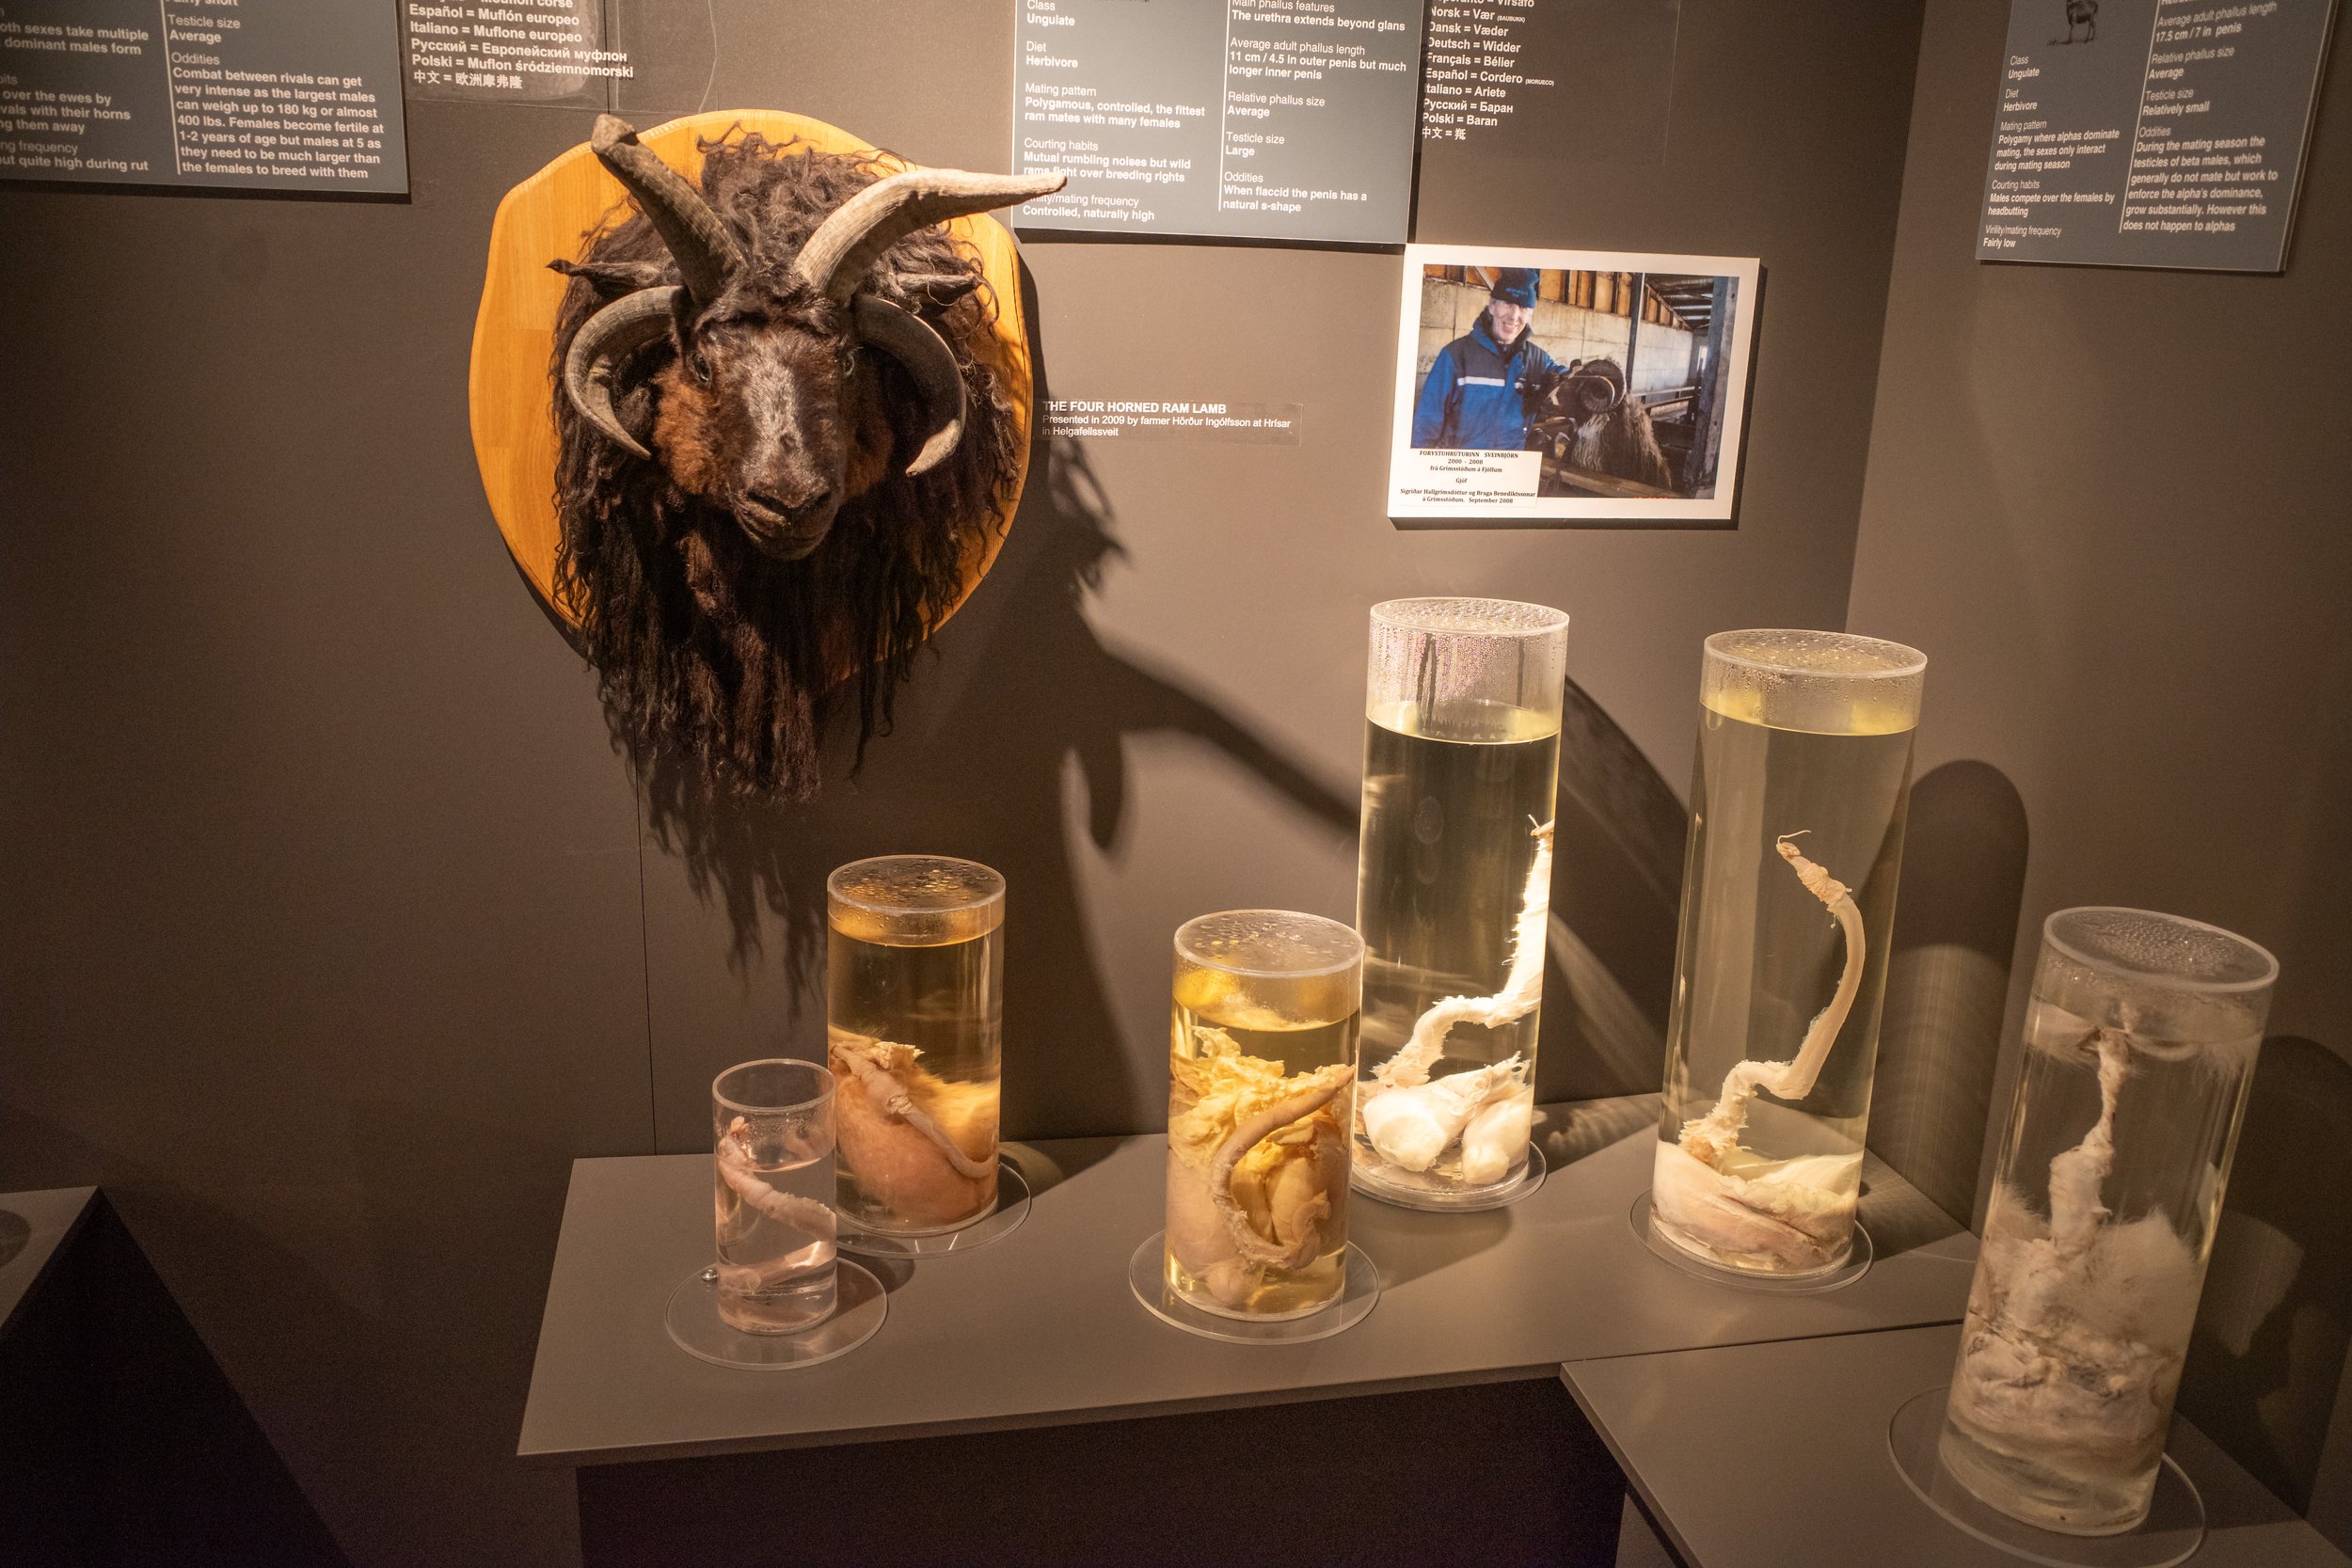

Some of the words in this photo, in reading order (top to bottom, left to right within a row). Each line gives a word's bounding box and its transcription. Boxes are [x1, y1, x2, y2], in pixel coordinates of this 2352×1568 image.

[538, 0, 572, 8] corse
[410, 5, 463, 19] Español
[478, 8, 522, 22] Muflón
[526, 13, 580, 26] europeo
[1026, 13, 1074, 26] Ungulate
[1232, 9, 1250, 21] The
[1253, 11, 1291, 23] urethra
[1294, 14, 1334, 25] extends
[1337, 16, 1375, 29] beyond
[1377, 19, 1405, 31] glans
[1431, 7, 1460, 18] Norsk
[1472, 9, 1496, 20] Vær
[167, 15, 215, 27] Testicle
[216, 17, 240, 28] size
[25, 27, 62, 36] sexes
[66, 26, 93, 38] take
[97, 29, 149, 41] multiple
[170, 29, 221, 44] Average
[410, 21, 458, 35] Italiano
[474, 24, 525, 39] Muflone
[529, 30, 581, 43] europeo
[1473, 24, 1507, 36] Væder
[411, 37, 467, 52] Русский
[482, 41, 570, 58] Европейский
[574, 48, 628, 62] муфлон
[1025, 40, 1046, 52] Diet
[1230, 37, 1270, 51] Average
[1273, 40, 1296, 51] adult
[1299, 41, 1333, 54] phallus
[1336, 43, 1364, 56] length
[1483, 40, 1520, 52] Widder
[412, 54, 452, 67] Polski
[468, 56, 511, 71] Muflon
[516, 60, 633, 78] śródziemnomorski
[1025, 55, 1077, 68] Herbivore
[1484, 56, 1514, 67] Bélier
[173, 67, 221, 80] Combat
[226, 70, 277, 82] between
[280, 71, 313, 84] rivals
[317, 75, 339, 85] can
[342, 75, 361, 87] get
[414, 71, 440, 85] 中文
[1229, 64, 1262, 77] longer
[1264, 66, 1291, 77] inner
[1294, 69, 1321, 80] penis
[1426, 69, 1467, 81] Español
[1480, 71, 1522, 83] Cordero
[2148, 69, 2184, 79] Average
[1025, 83, 1058, 96] Mating
[1061, 85, 1096, 97] pattern
[1426, 84, 1462, 95] taliano
[1474, 87, 1505, 97] Ariete
[1025, 96, 1093, 111] Polygamous,
[1097, 101, 1152, 115] controlled,
[1155, 103, 1172, 114] the
[1175, 104, 1204, 116] fittest
[1227, 104, 1269, 119] Average
[1424, 100, 1467, 111] Русский
[1479, 103, 1513, 115] Баран
[2003, 102, 2037, 111] Herbivore
[2142, 103, 2183, 116] Relatively
[2185, 102, 2209, 113] small
[177, 115, 199, 126] 400
[203, 116, 227, 127] lbs.
[229, 117, 279, 129] Females
[284, 119, 331, 132] become
[335, 120, 369, 133] fertile
[372, 122, 384, 134] at
[1025, 113, 1044, 121] ram
[1048, 112, 1080, 123] mates
[1083, 113, 1104, 124] with
[1107, 117, 1136, 128] many
[1139, 116, 1180, 128] females
[1422, 113, 1454, 123] Polski
[1466, 115, 1497, 126] Baran
[1226, 131, 1263, 143] Testicle
[1265, 133, 1284, 144] size
[1422, 127, 1441, 139] 中文
[1225, 144, 1254, 158] Large
[2136, 141, 2164, 153] During
[2166, 140, 2180, 150] the
[2181, 139, 2212, 150] mating
[2214, 139, 2248, 149] season
[2249, 136, 2265, 147] the
[1024, 150, 1058, 163] Mutual
[1062, 153, 1108, 167] rumbling
[1112, 155, 1146, 166] noises
[1150, 157, 1167, 167] but
[1169, 158, 1190, 168] wild
[181, 161, 201, 172] the
[205, 161, 252, 174] females
[257, 163, 268, 174] to
[272, 164, 307, 176] breed
[310, 166, 335, 177] with
[338, 166, 368, 178] them
[1223, 184, 1252, 196] When
[1255, 185, 1289, 197] flaccid
[1291, 187, 1307, 198] the
[1310, 189, 1337, 200] penis
[1340, 189, 1358, 200] has
[1222, 198, 1258, 210] natural
[1261, 199, 1300, 213] s-shape
[1987, 205, 2028, 217] headbutting
[2122, 219, 2143, 230] does
[2144, 219, 2159, 230] not
[2160, 219, 2192, 232] happen
[2193, 220, 2203, 230] to
[2204, 220, 2235, 232] alphas
[1982, 237, 2002, 248] Fairly
[2002, 238, 2015, 247] low
[1042, 402, 1067, 411] THE
[1068, 403, 1104, 412] FOUR
[1107, 403, 1159, 413] HORNED
[1162, 404, 1189, 413] RAM
[1192, 404, 1226, 414] LAMB
[1043, 415, 1089, 424] Presented
[1090, 416, 1099, 424] in
[1102, 416, 1124, 424] 2009
[1127, 417, 1138, 426] by
[1140, 417, 1169, 425] farmer
[1172, 417, 1201, 426] Hörður
[1205, 418, 1249, 428] Ingólfsson
[1252, 419, 1262, 427] at
[1263, 419, 1291, 427] Hrísar
[1053, 427, 1118, 437] Helgafellssveit
